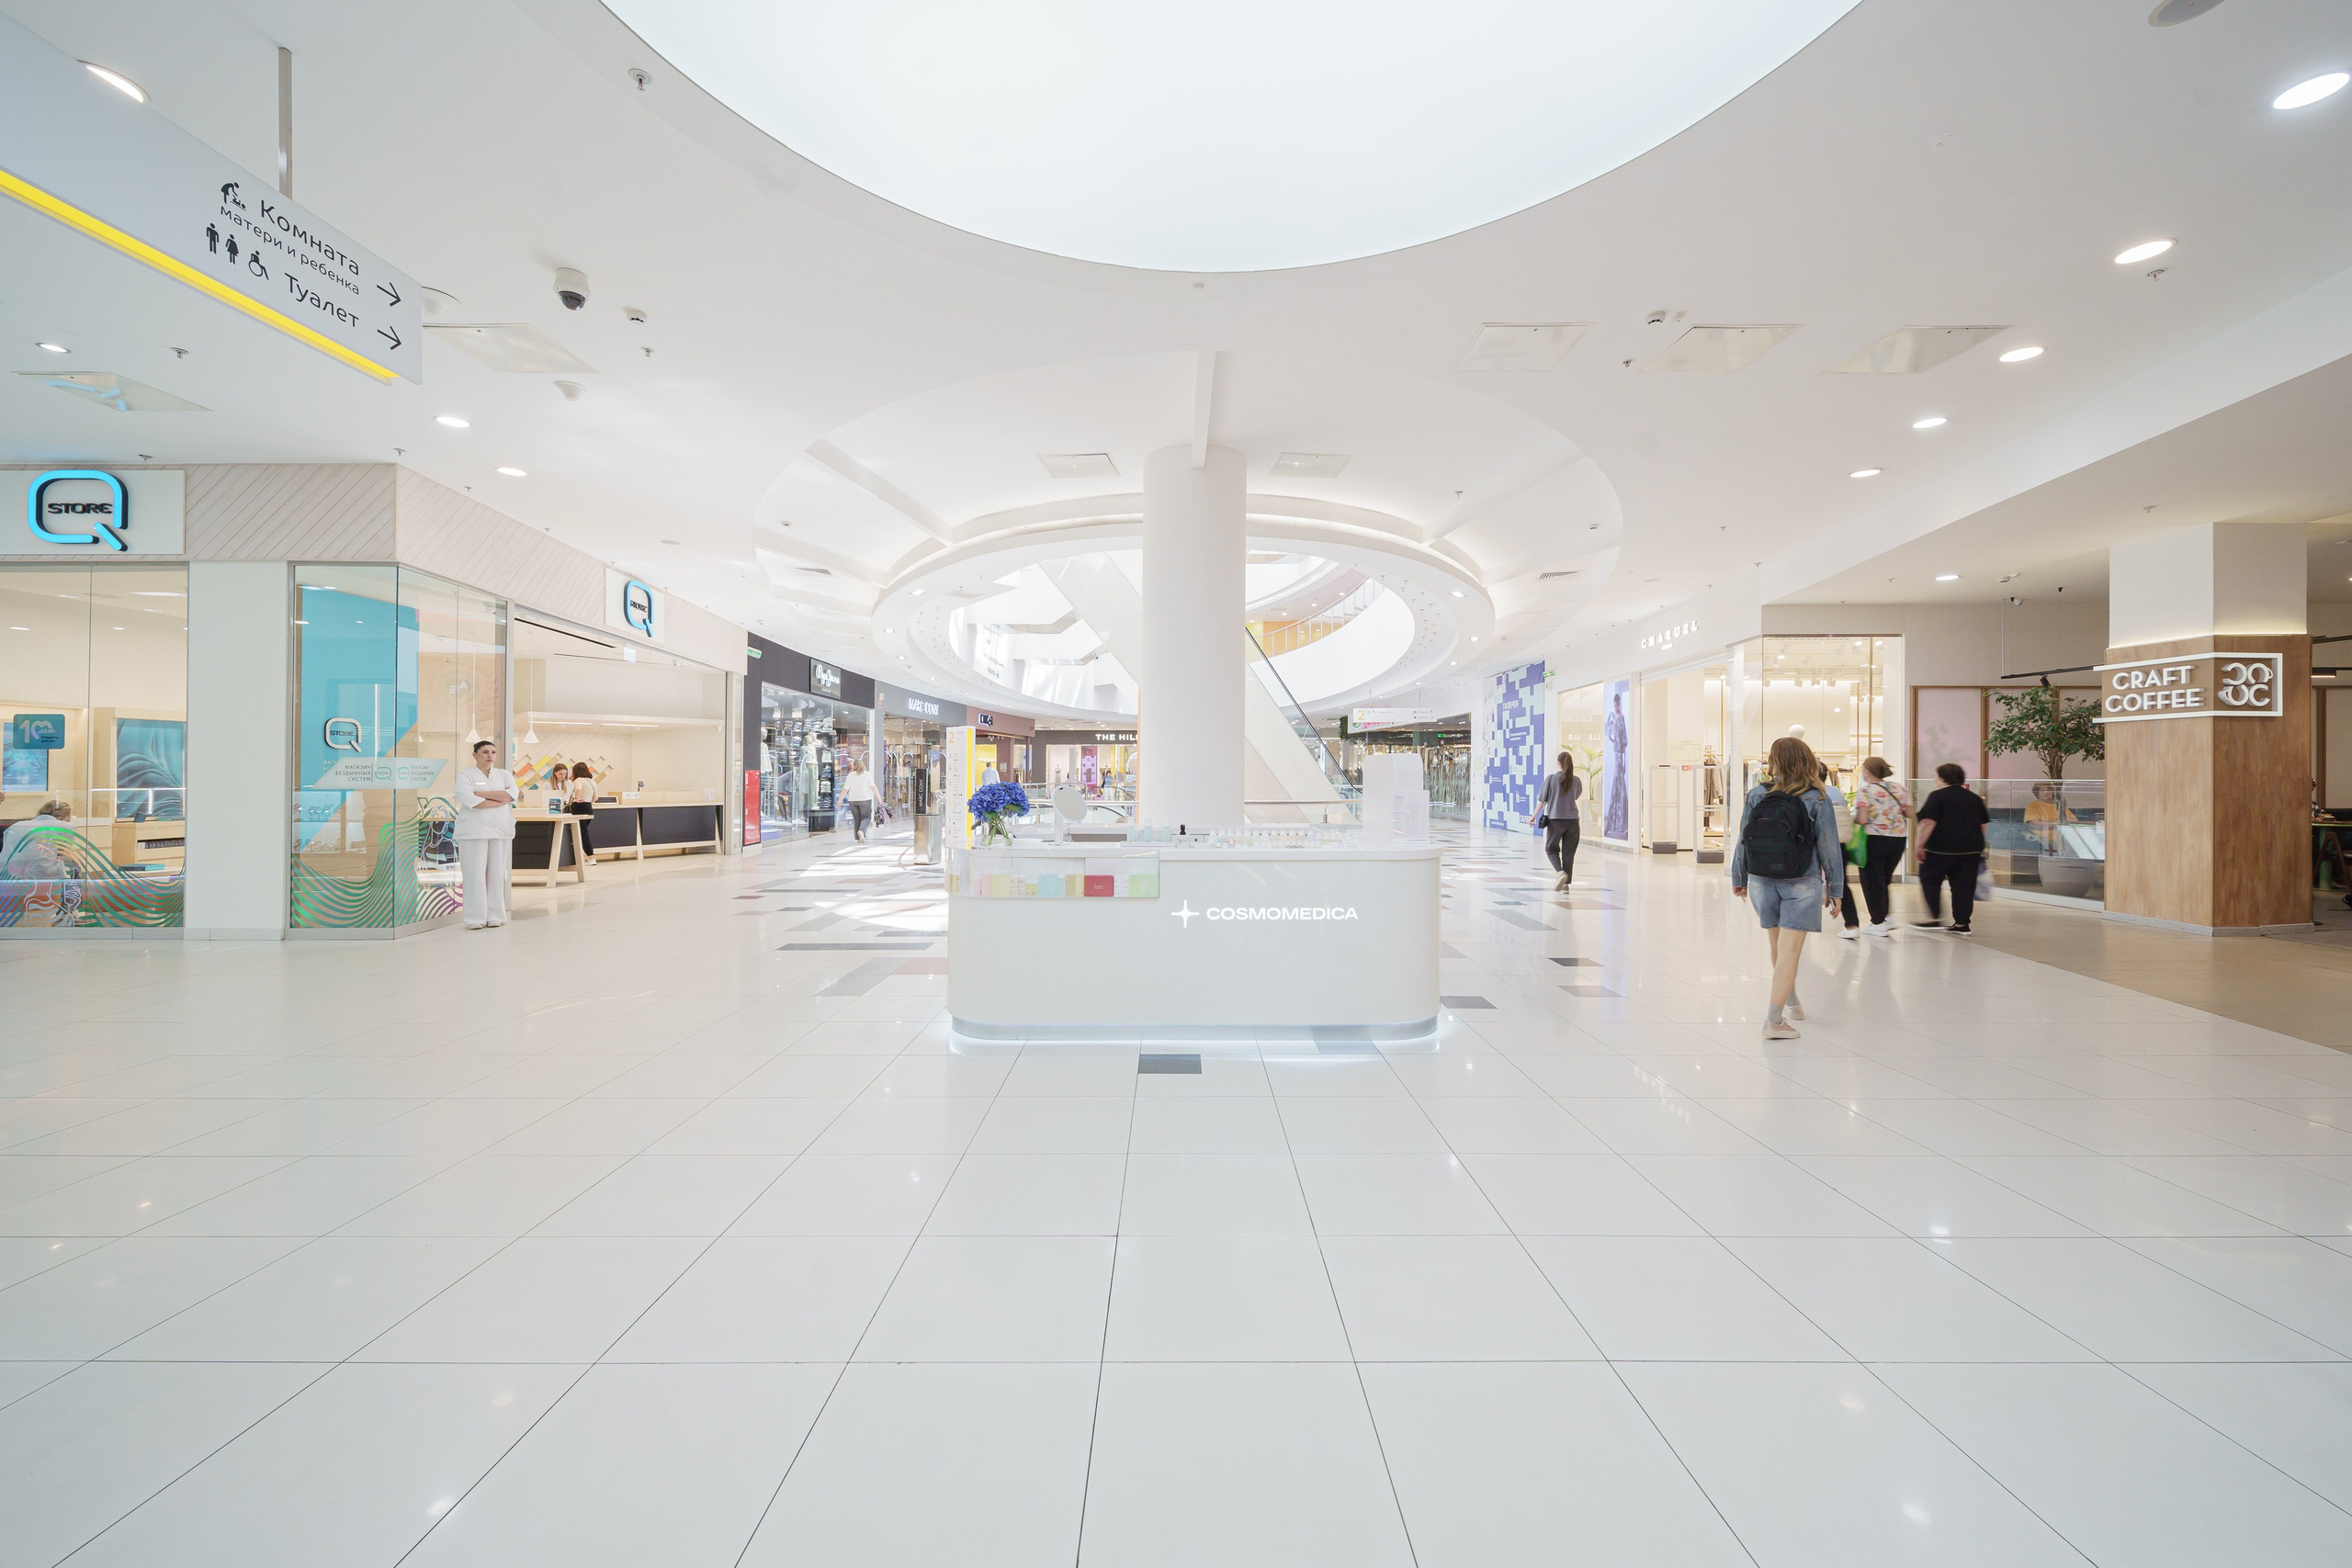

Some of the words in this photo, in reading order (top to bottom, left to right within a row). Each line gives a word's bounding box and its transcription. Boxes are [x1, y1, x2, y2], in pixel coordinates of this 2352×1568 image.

[260, 198, 360, 276] Комната
[220, 205, 283, 250] матери
[287, 245, 297, 259] и
[300, 253, 360, 296] ребенка
[284, 272, 360, 329] Туалет
[47, 502, 113, 514] STORE
[1641, 620, 1698, 649] CHARUEL
[2112, 665, 2195, 690] CRAFT
[2105, 688, 2204, 713] COFFEE
[1357, 709, 1365, 721] 2
[949, 732, 954, 743] 2
[1095, 733, 1116, 741] THE
[1206, 907, 1359, 920] COSMOMEDICA
